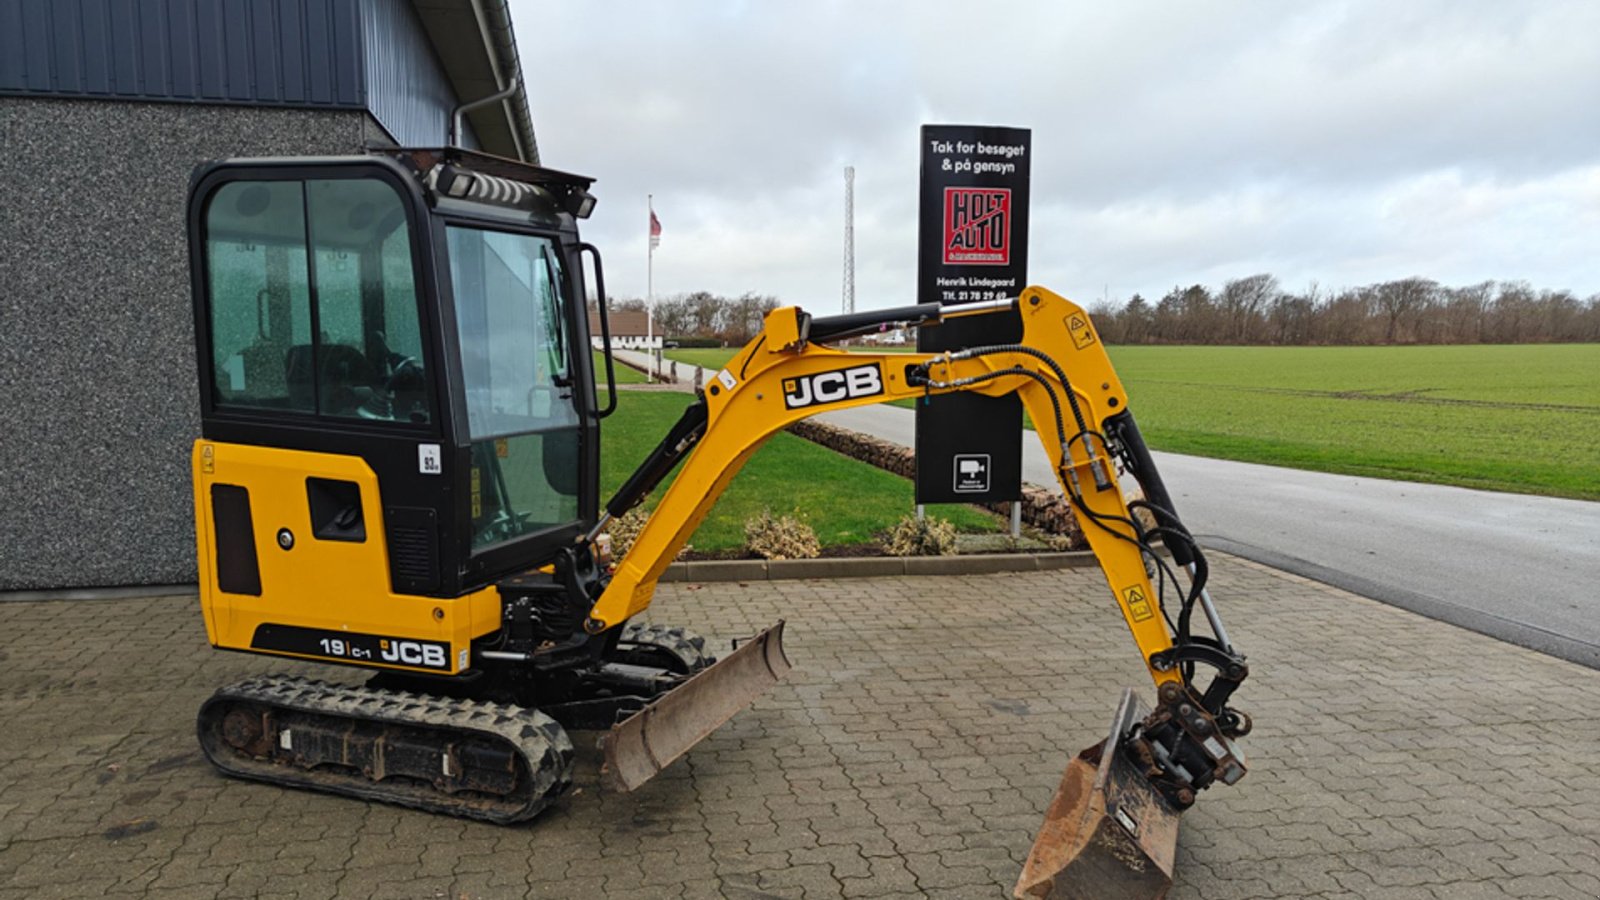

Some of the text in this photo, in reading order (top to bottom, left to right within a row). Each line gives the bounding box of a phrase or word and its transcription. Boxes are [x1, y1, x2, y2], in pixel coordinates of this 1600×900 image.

[931, 140, 1025, 158] Tak for besøget
[941, 158, 1015, 175] & på gensyn
[953, 192, 1005, 231] HOLT
[950, 210, 1005, 249] AUTO
[936, 277, 1016, 289] Henrik Lindegaard
[958, 291, 968, 300] 21
[983, 291, 994, 300] 29
[786, 366, 880, 408] JCB
[320, 638, 344, 656] 19
[381, 640, 446, 667] JCB
